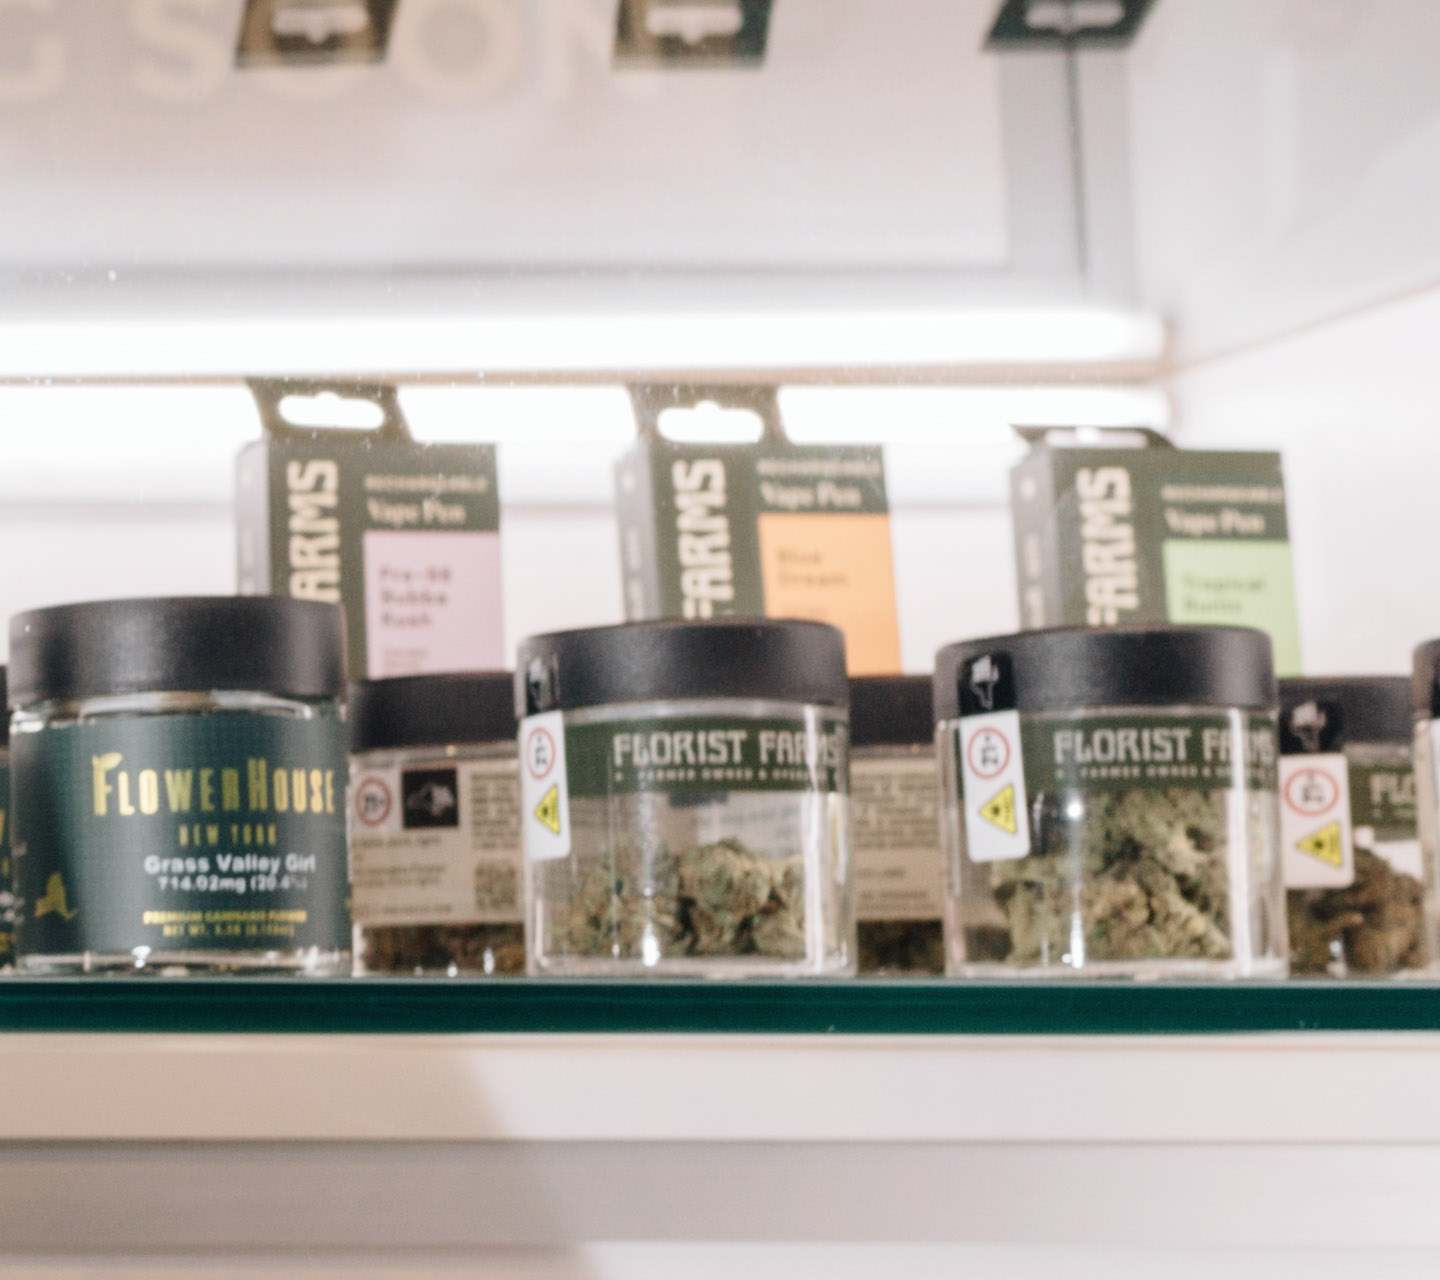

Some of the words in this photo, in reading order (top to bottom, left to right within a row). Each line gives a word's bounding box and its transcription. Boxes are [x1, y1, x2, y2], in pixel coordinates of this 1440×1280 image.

[613, 729, 748, 767] FLORIST
[1053, 728, 1192, 764] FLORIST
[143, 852, 211, 874] Grass
[215, 852, 281, 876] Valley
[284, 852, 317, 873] Girl
